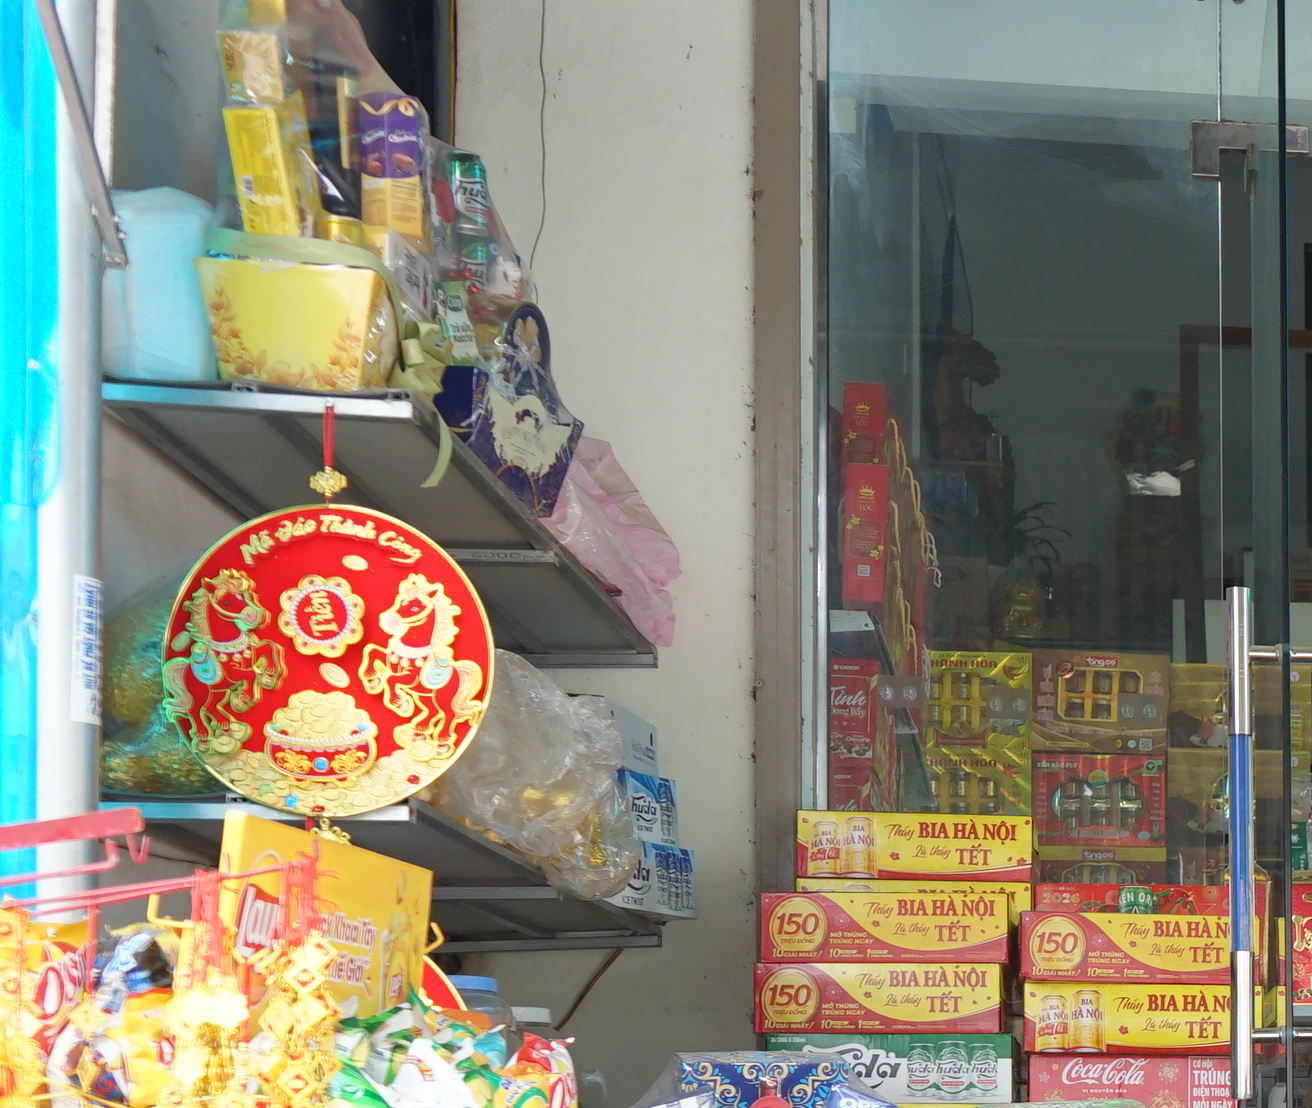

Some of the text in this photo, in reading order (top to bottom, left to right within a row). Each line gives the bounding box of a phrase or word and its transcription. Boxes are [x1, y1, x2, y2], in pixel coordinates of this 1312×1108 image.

[320, 515, 377, 539] Thành
[378, 531, 422, 565] Công
[884, 819, 1017, 845] Thấy BIA HÀ NỘI
[956, 844, 992, 866] TẾT
[863, 894, 995, 923] Thấy BIA HÀ NỘI
[776, 913, 820, 935] 150
[934, 920, 971, 943] TẾT
[1121, 916, 1214, 938] Thấy BIA HÀ
[1036, 932, 1079, 954] 150
[1189, 942, 1225, 964] TẾT
[854, 965, 987, 991] Thấy BIA HÀ NỘI
[768, 984, 812, 1007] 150
[926, 991, 963, 1013] TẾT
[1113, 990, 1212, 1013] Thấy BIA HÀ
[1185, 1016, 1222, 1039] TẾT
[1062, 1057, 1150, 1085] Coca-Cola
